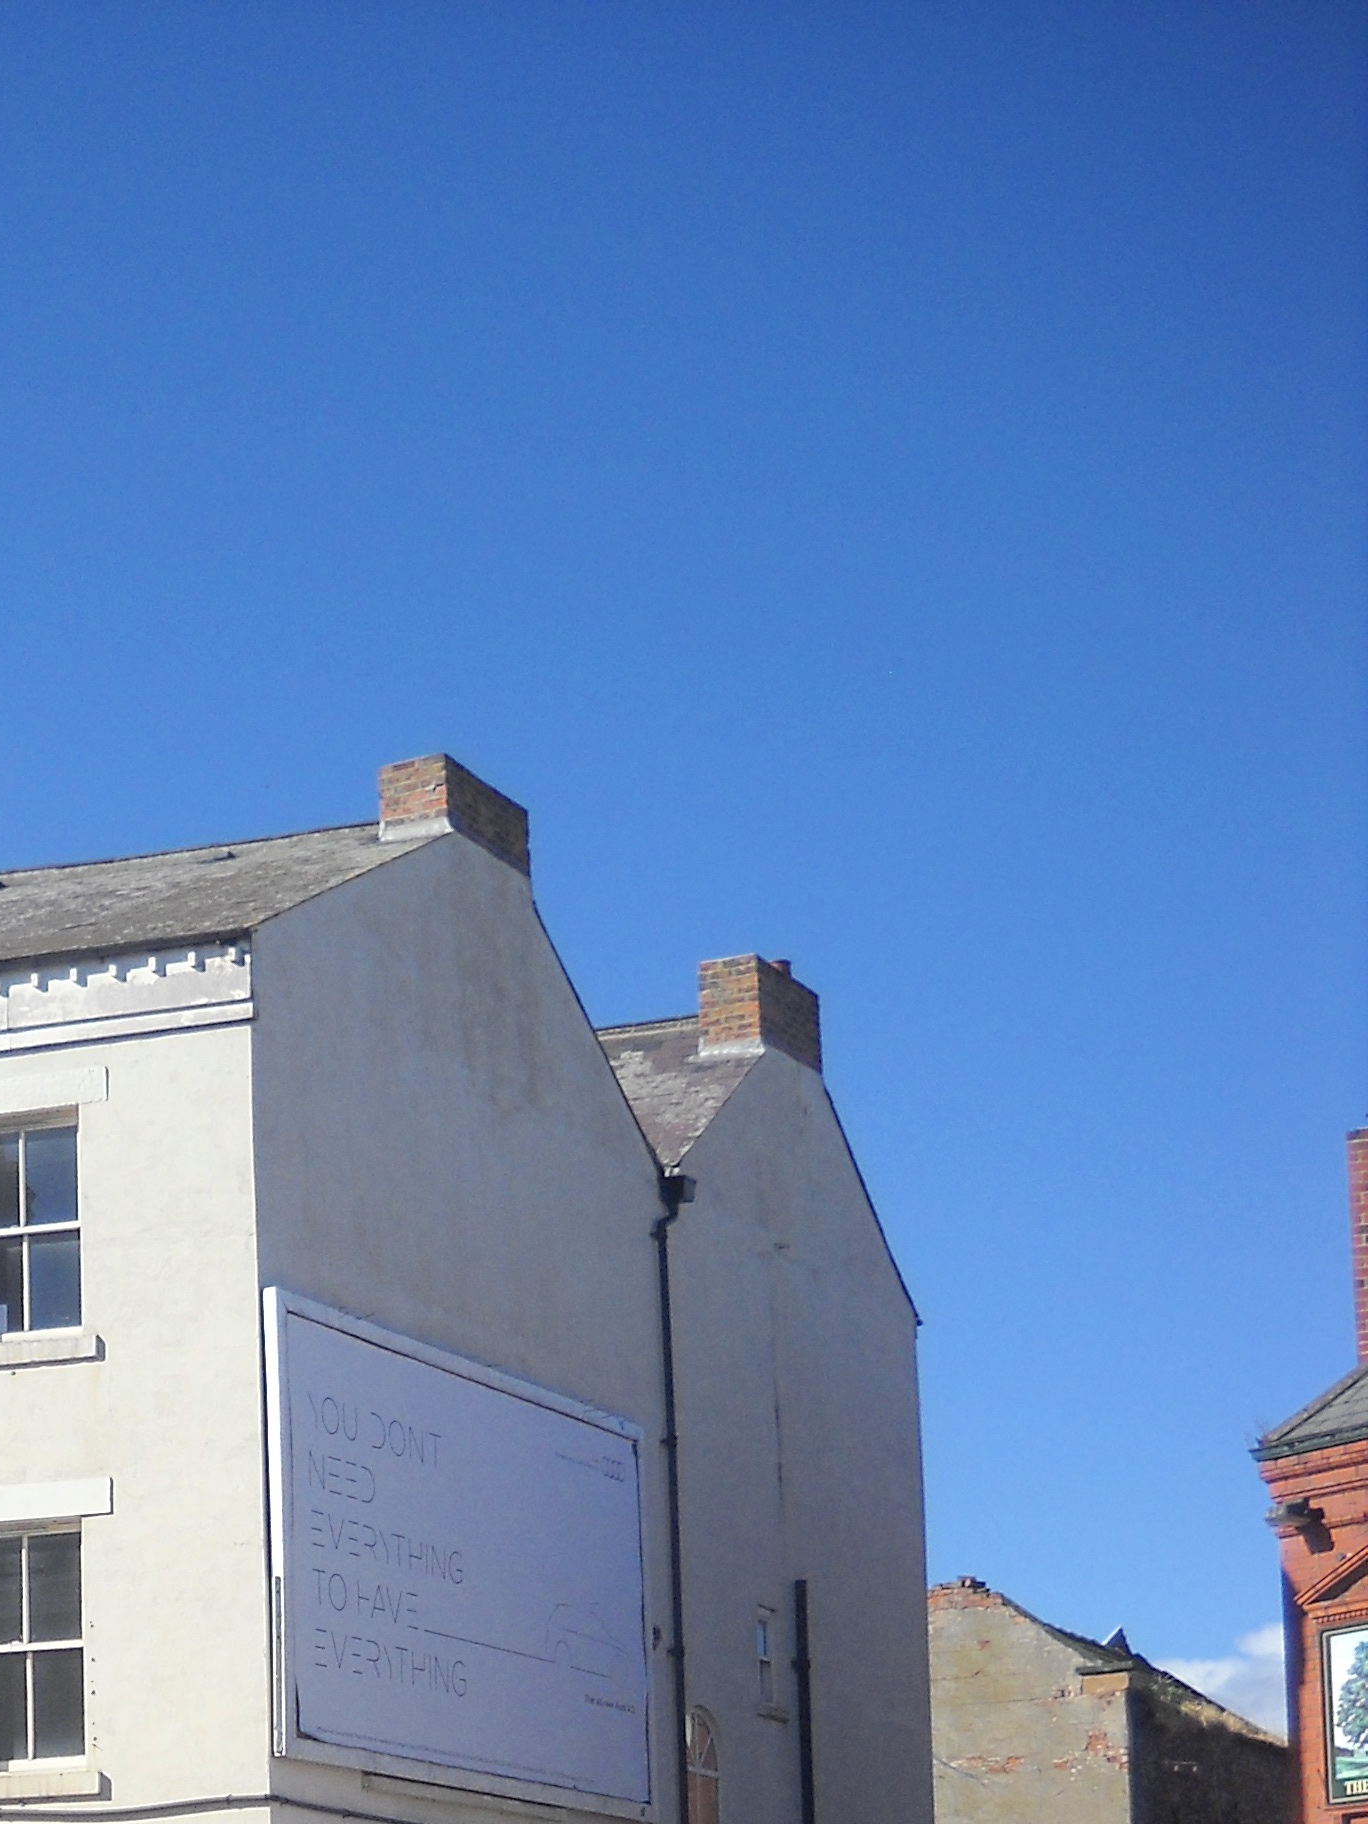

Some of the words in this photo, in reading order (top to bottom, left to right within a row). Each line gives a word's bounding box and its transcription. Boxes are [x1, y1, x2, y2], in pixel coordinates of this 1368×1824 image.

[308, 1392, 357, 1441] YOU
[308, 1450, 376, 1504] NEED
[311, 1509, 464, 1585] EVERYTHING
[312, 1568, 347, 1612] TO
[356, 1579, 419, 1630] HAVE
[315, 1627, 468, 1698] EVERYTHING
